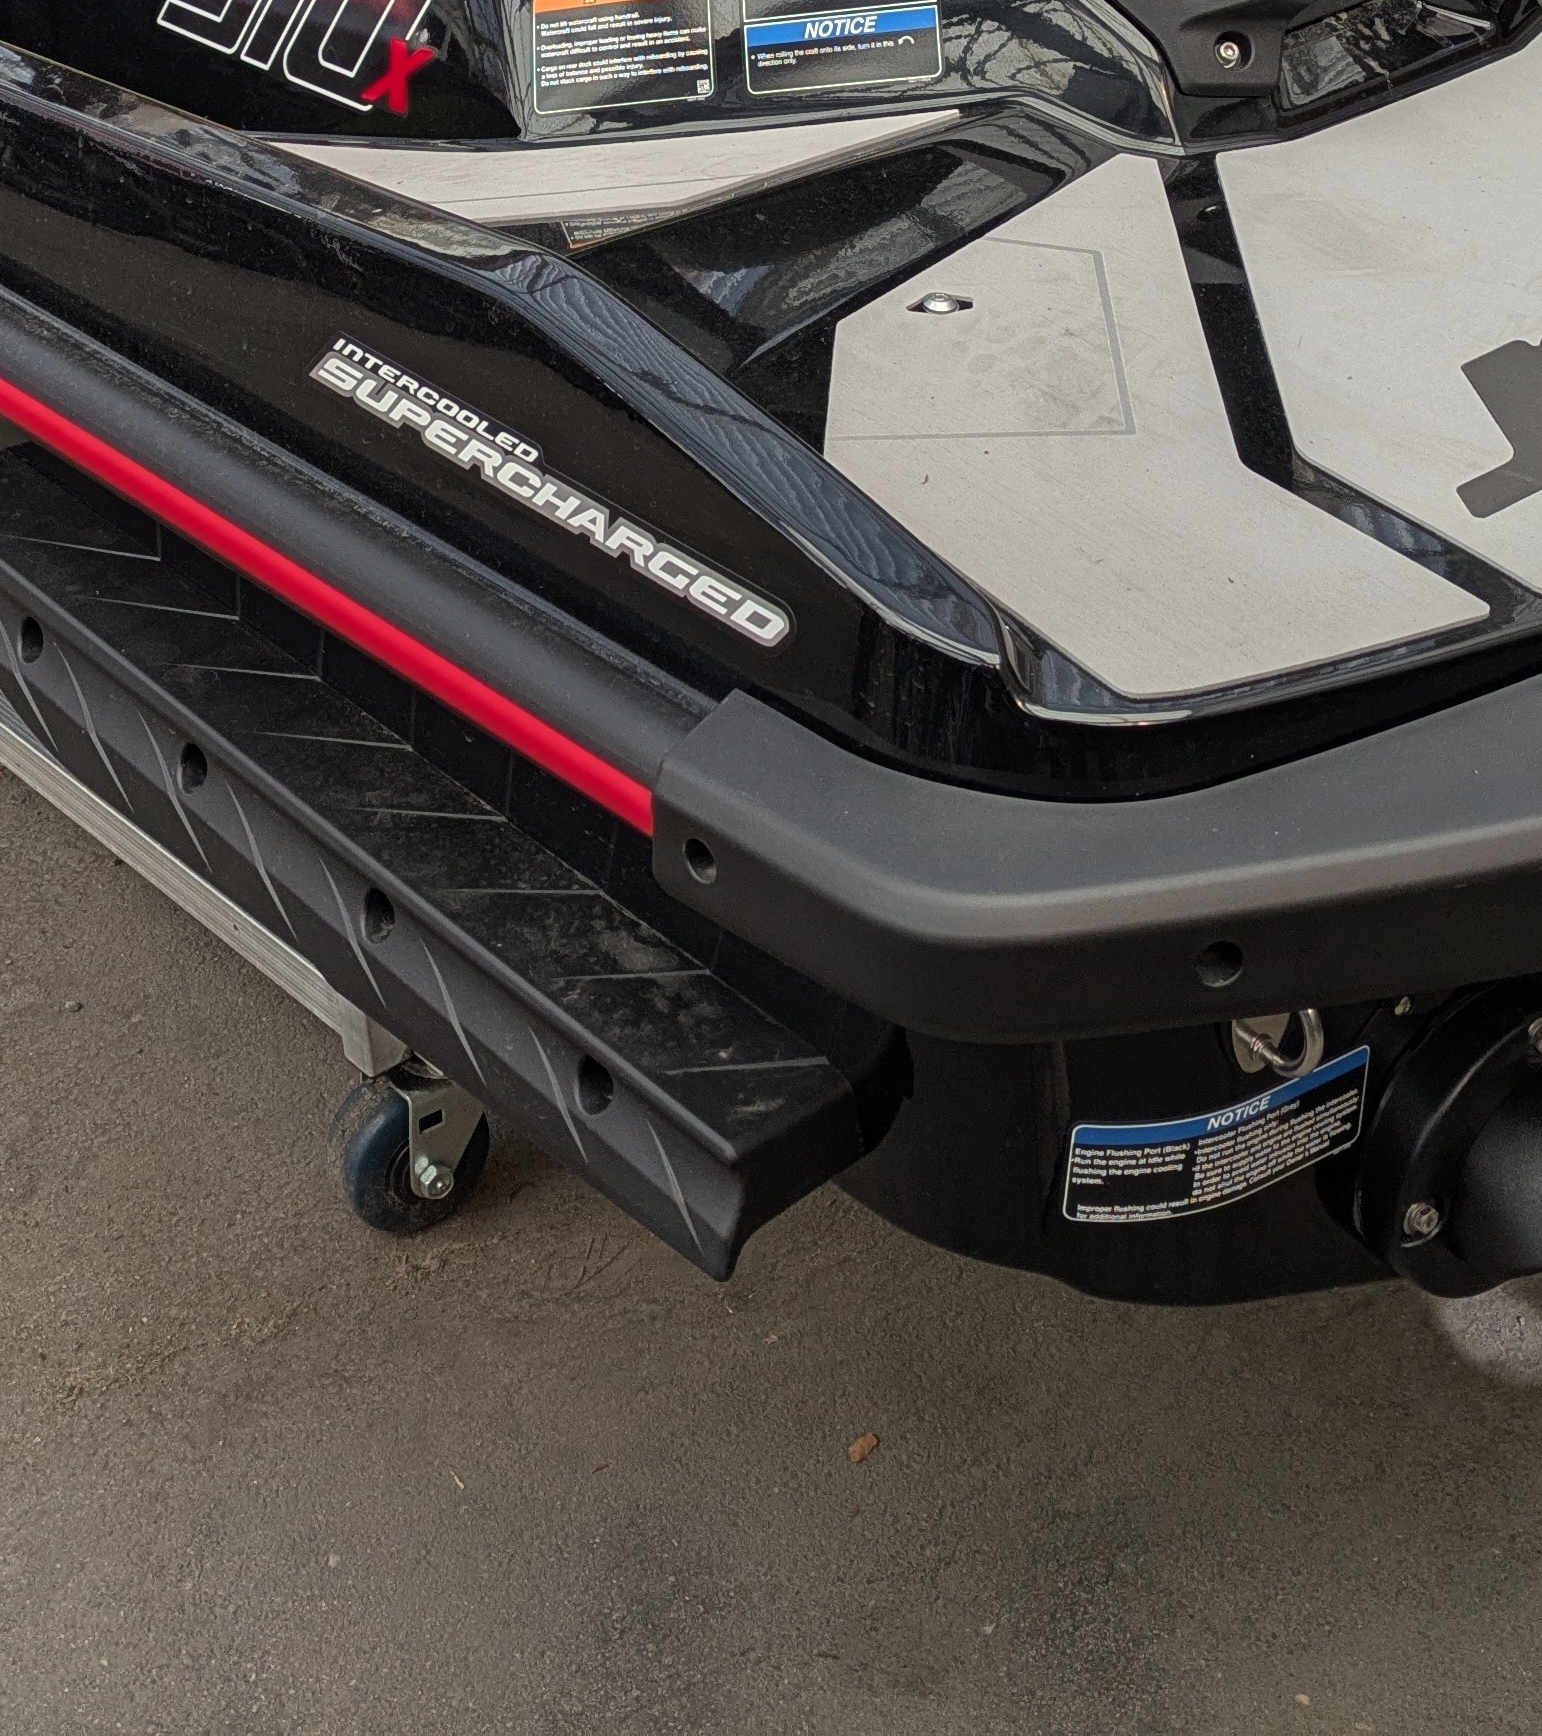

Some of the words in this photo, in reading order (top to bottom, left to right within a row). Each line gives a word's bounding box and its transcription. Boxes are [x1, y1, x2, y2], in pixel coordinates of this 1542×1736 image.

[804, 15, 878, 39] NOTICE
[332, 338, 539, 463] INTERCOOLED
[317, 358, 790, 642] SUPERCHARGED
[1207, 1095, 1271, 1131] NOTICE
